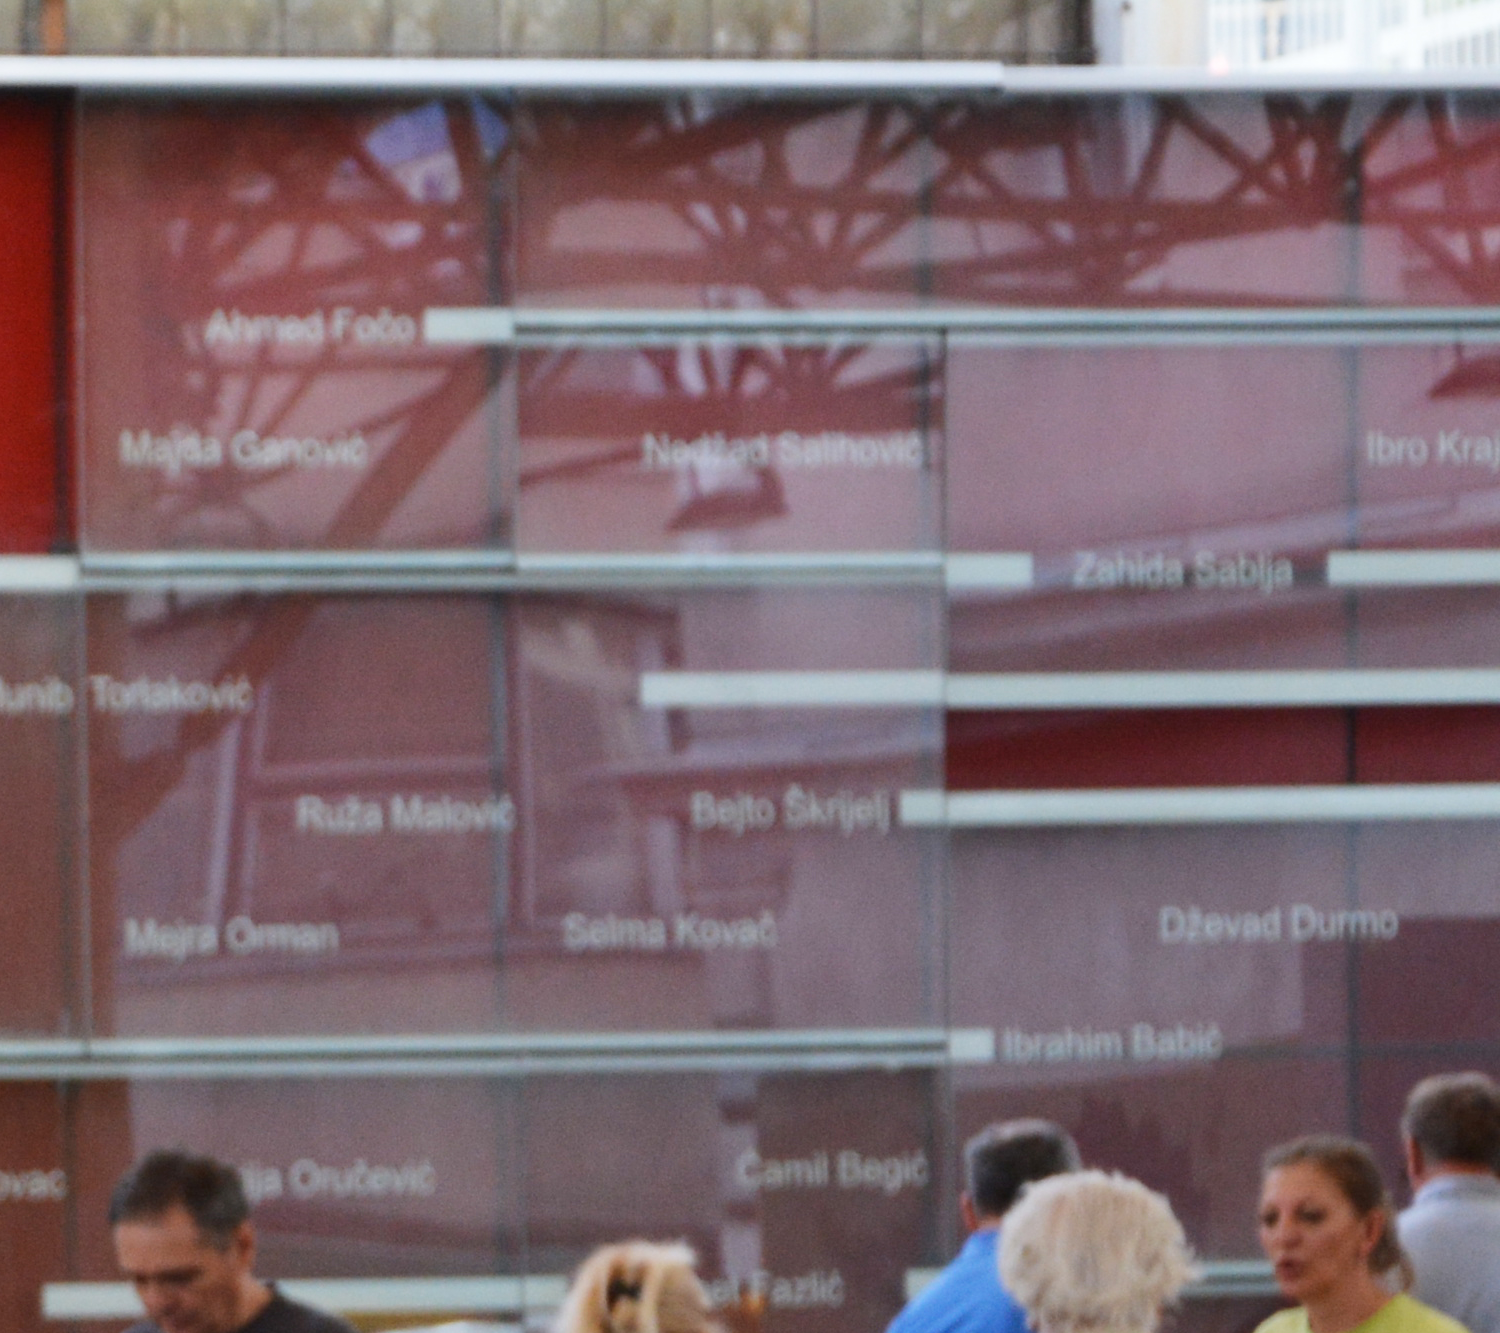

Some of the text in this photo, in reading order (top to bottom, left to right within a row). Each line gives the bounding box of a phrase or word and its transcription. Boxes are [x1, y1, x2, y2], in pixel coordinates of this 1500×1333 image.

[205, 307, 324, 348] Ahmed
[1366, 430, 1500, 474] Ibro Kraj
